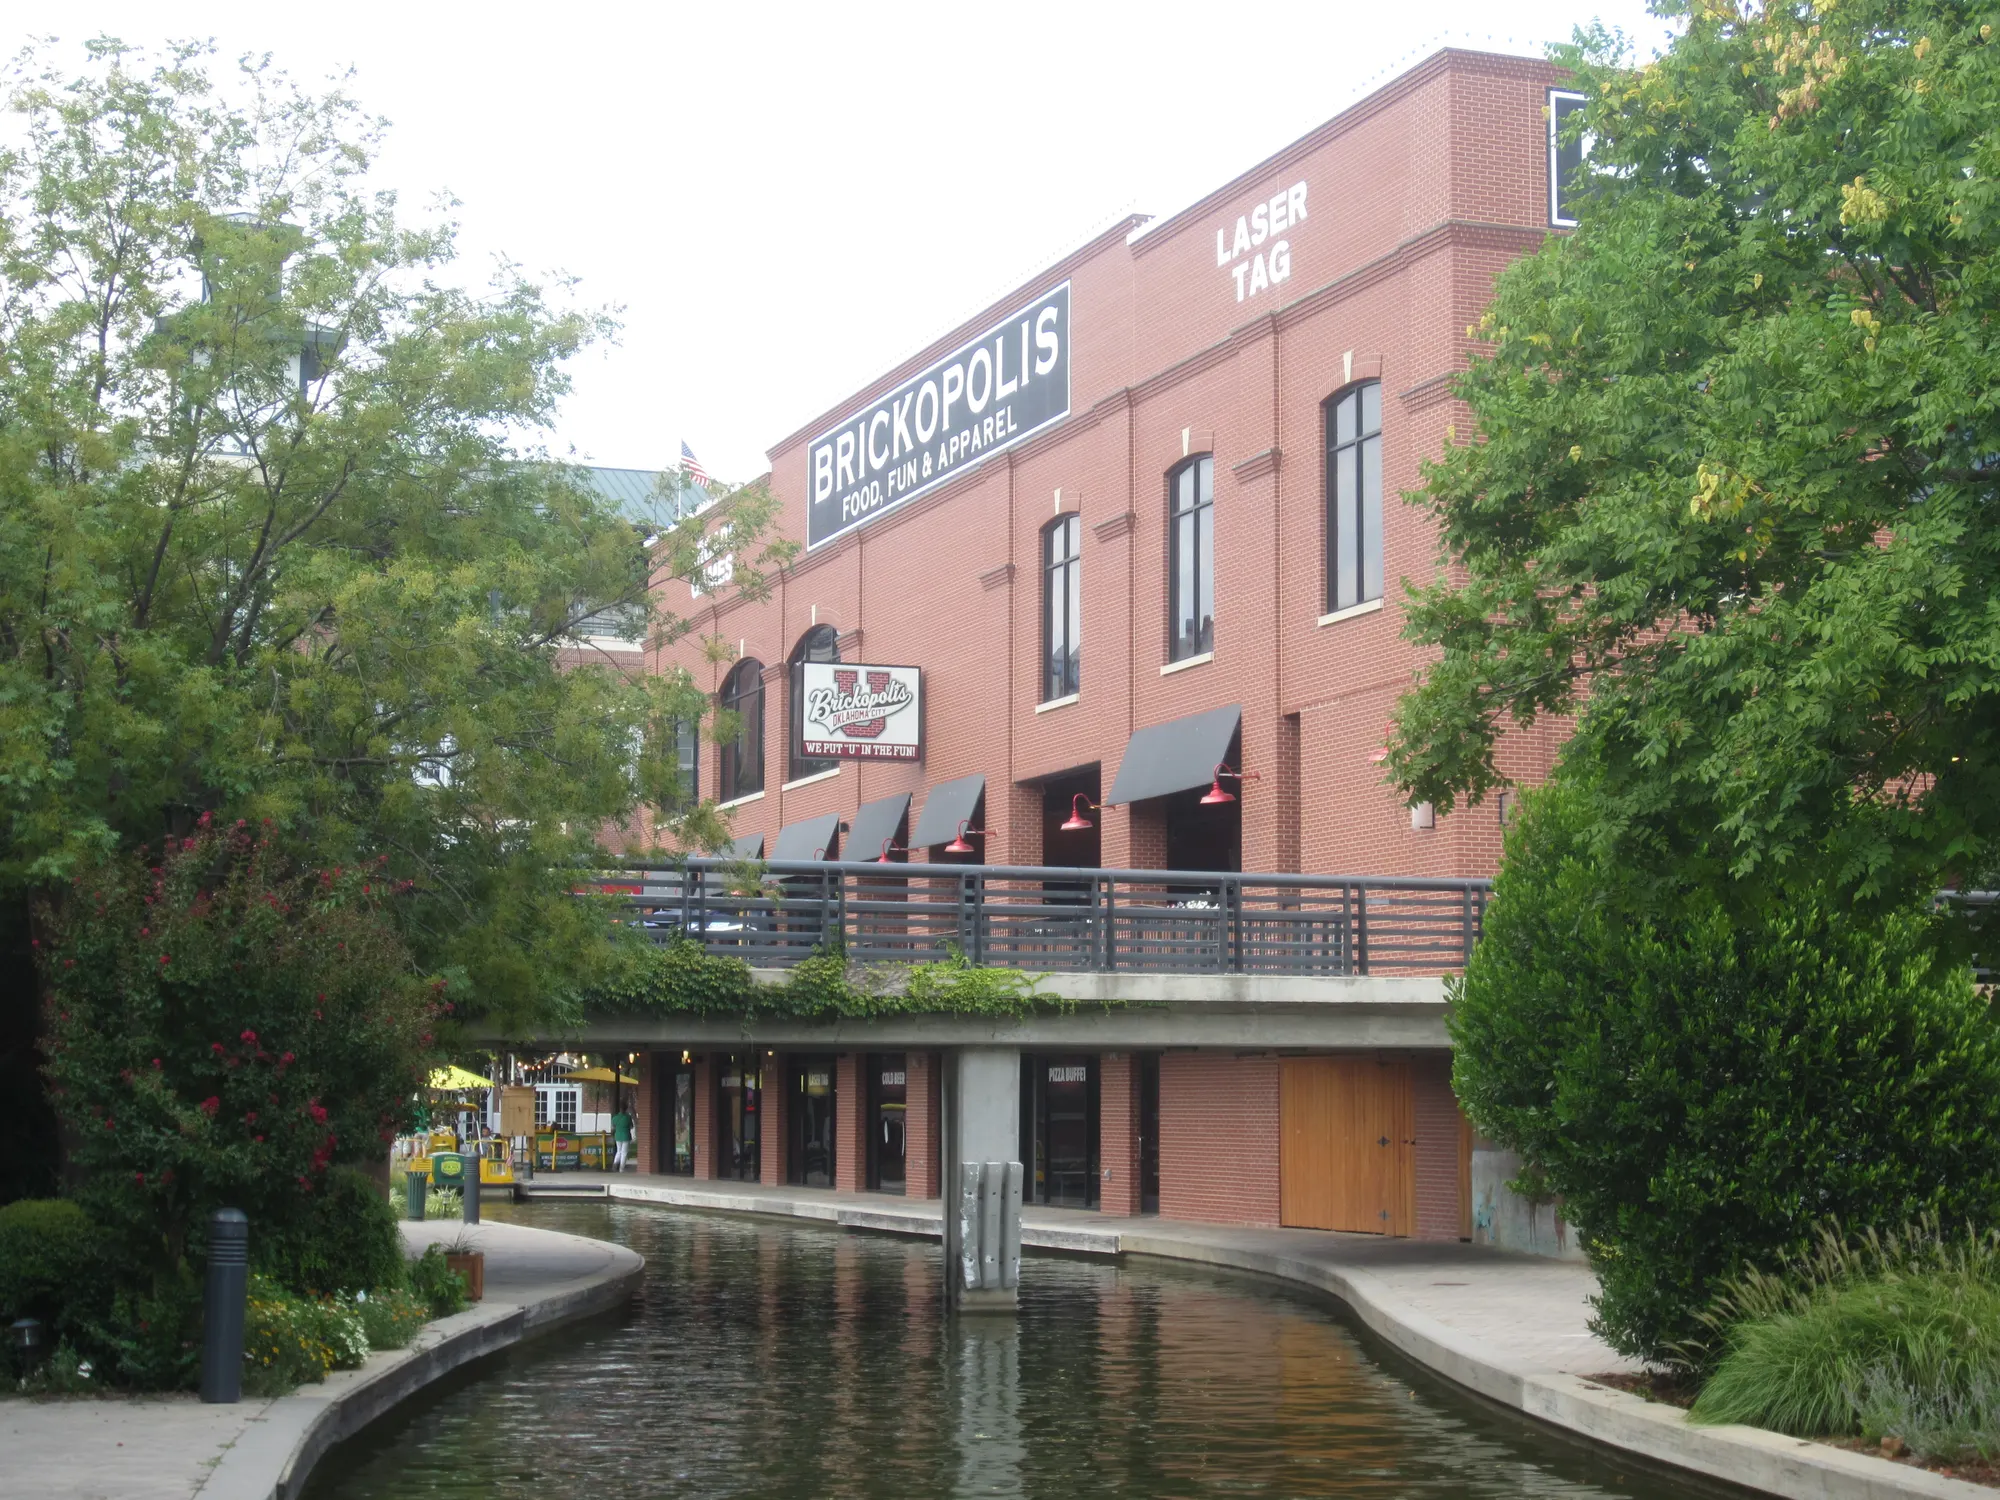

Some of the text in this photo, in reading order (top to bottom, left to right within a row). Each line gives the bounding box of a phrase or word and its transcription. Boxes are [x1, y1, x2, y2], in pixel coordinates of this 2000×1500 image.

[1217, 180, 1308, 267] LASER
[1231, 240, 1291, 303] TAG
[814, 305, 1059, 505] BRICKOPOLIS
[842, 405, 1018, 522] FOOD, FUN & APPAREL
[691, 553, 733, 599] MES
[809, 680, 912, 722] Brickopolis
[832, 708, 887, 727] OKLAHOMA CITY
[806, 742, 822, 753] WE
[823, 743, 843, 754] PUT
[861, 744, 871, 755] IN
[873, 745, 892, 756] THE
[893, 746, 916, 757] FUN!
[882, 1071, 905, 1085] COLD BEER
[1048, 1067, 1086, 1082] PIZZA BUFFET
